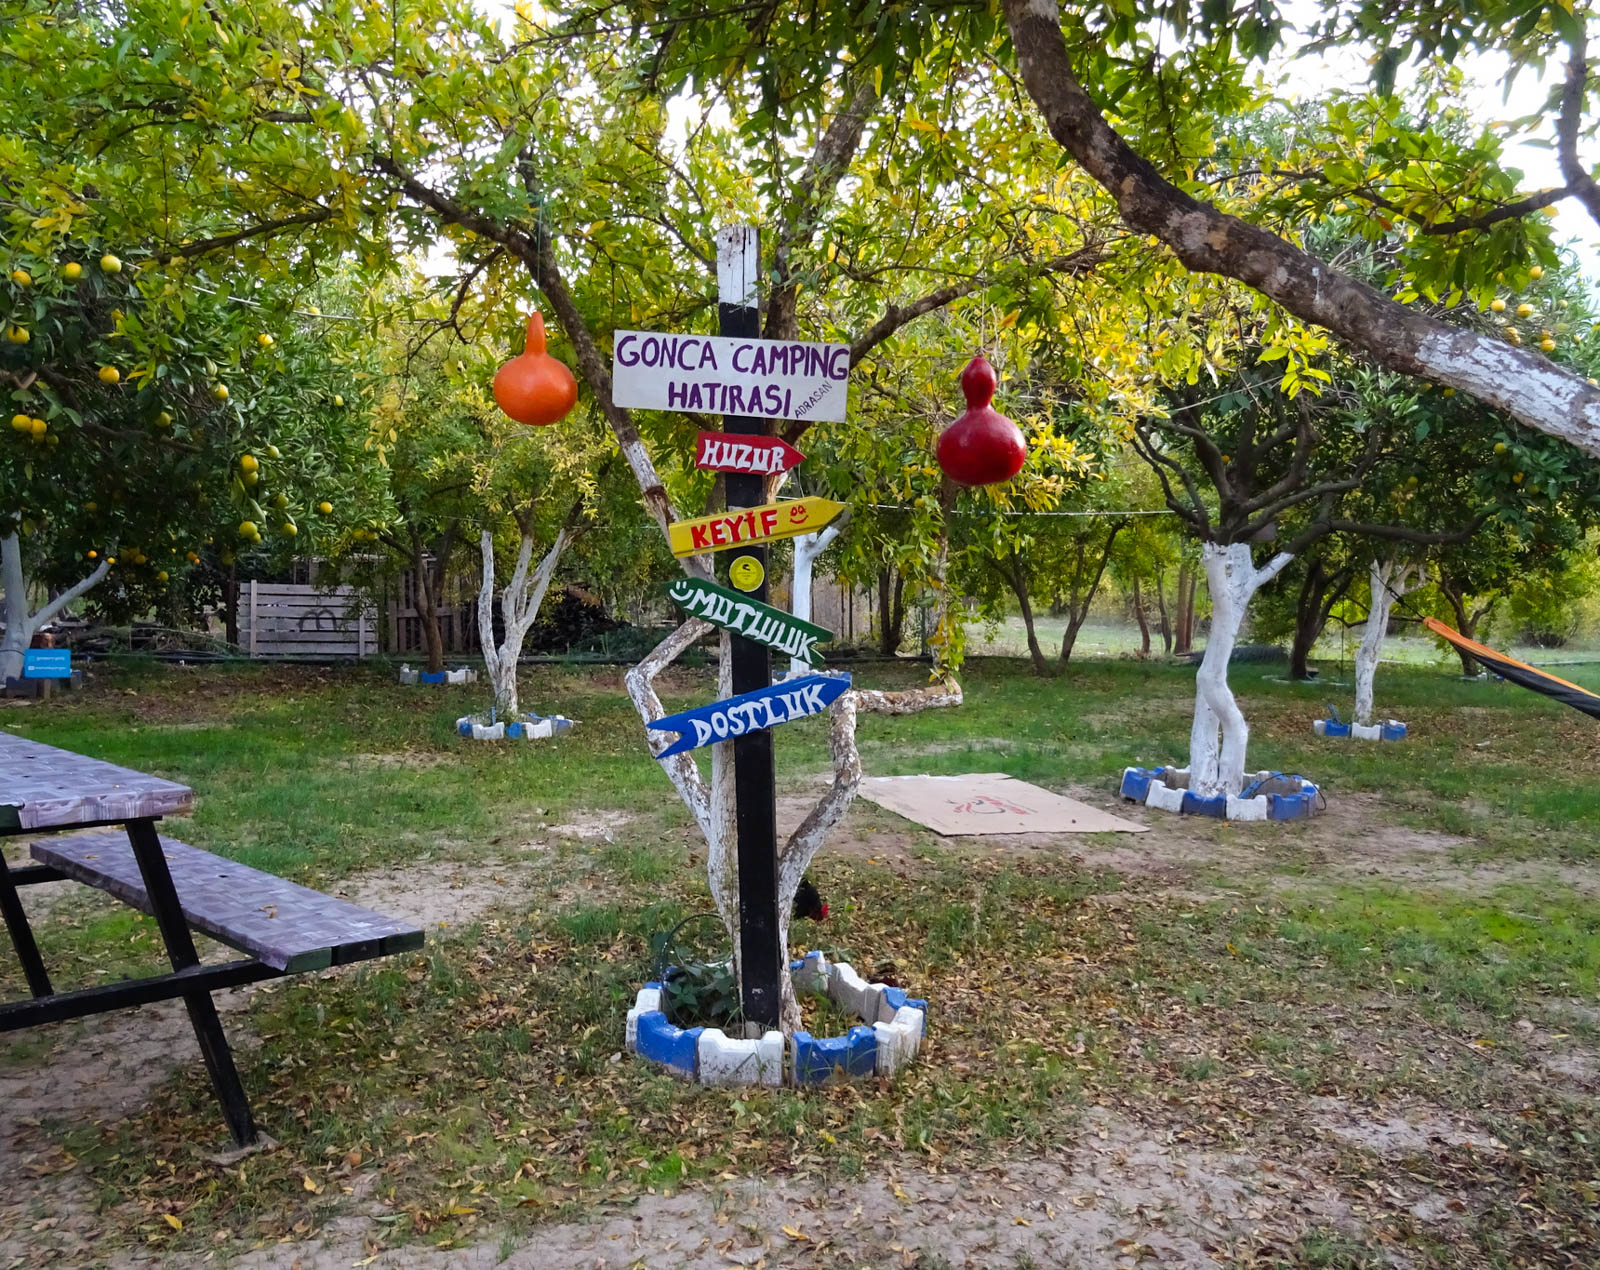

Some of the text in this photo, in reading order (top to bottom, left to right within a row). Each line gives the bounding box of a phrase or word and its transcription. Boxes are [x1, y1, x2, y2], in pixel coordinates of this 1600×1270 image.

[616, 335, 850, 380] GONCA CAMPING
[668, 382, 791, 417] HATIRASI
[794, 380, 833, 418] ADRASAN
[698, 439, 786, 475] HUZUR
[685, 588, 817, 664] MUTLULUK
[688, 683, 827, 748] DOSTLUK
